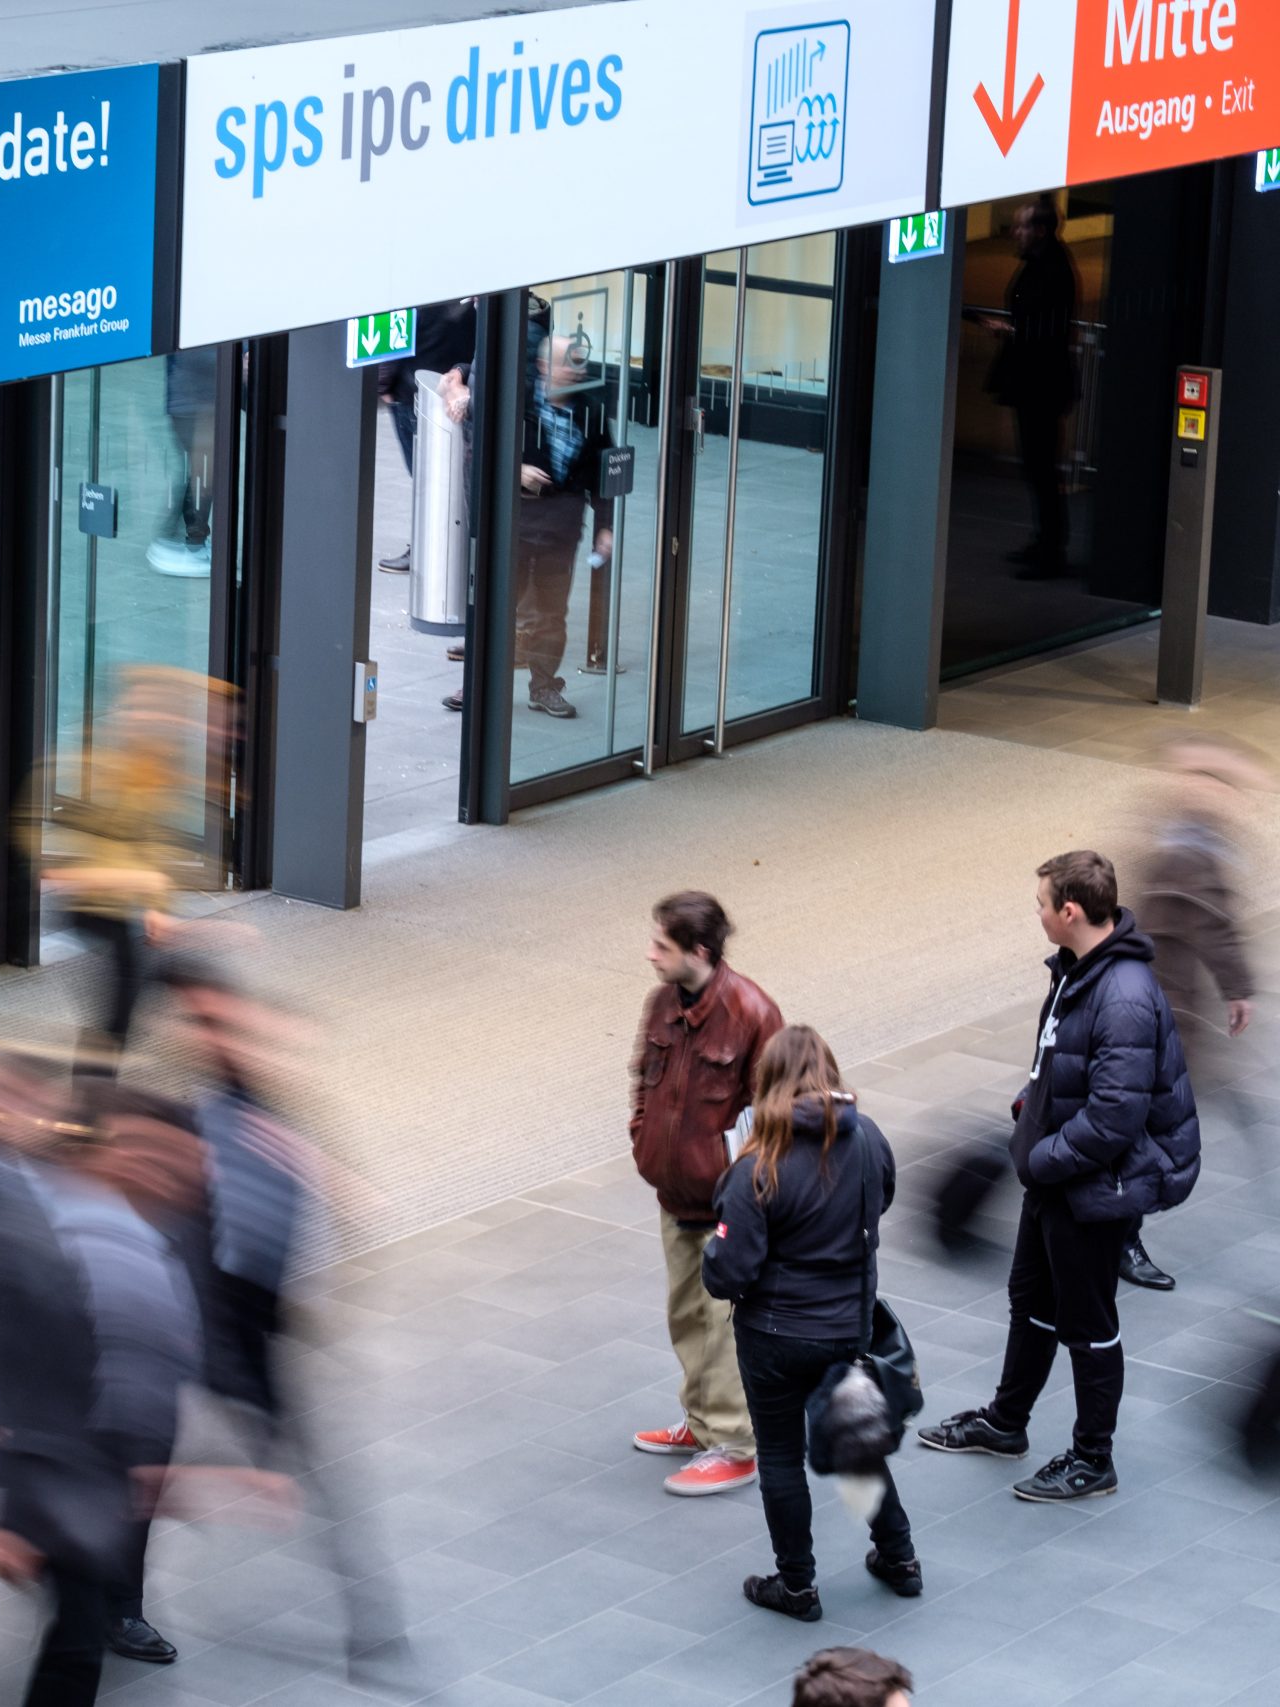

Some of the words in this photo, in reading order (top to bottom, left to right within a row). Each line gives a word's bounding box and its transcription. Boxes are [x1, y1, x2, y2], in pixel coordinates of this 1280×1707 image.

[1103, 0, 1237, 68] Mitte
[213, 94, 324, 200] sps
[340, 63, 432, 184] ipc
[445, 40, 624, 146] drives
[1095, 94, 1196, 140] Ausgang
[1221, 76, 1255, 116] Exit
[19, 285, 117, 324] mesago
[19, 332, 52, 347] Messe
[53, 322, 98, 341] Frankfurt
[100, 318, 129, 333] Group
